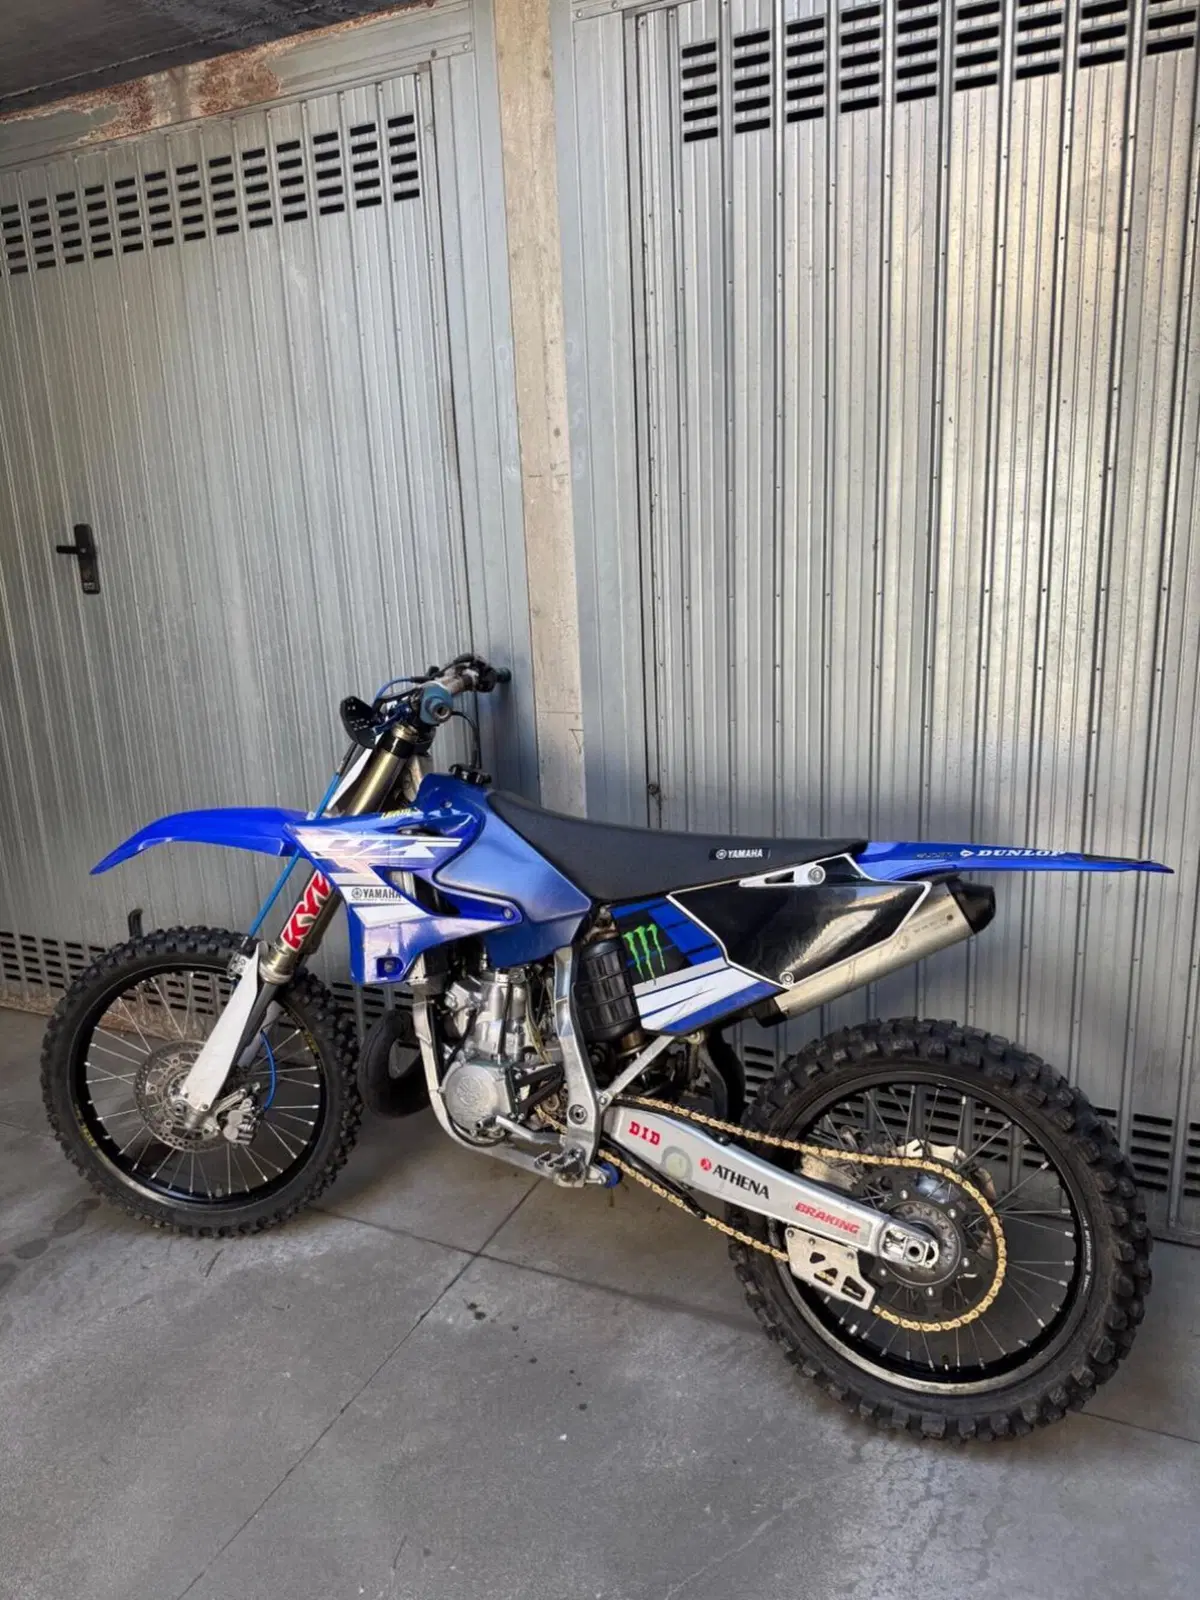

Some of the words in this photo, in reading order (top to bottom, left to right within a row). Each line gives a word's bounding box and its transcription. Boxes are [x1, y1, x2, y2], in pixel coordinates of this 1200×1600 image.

[728, 848, 763, 859] YAMAHA
[976, 849, 1066, 857] DUNLOP
[629, 1121, 660, 1146] DID
[712, 1165, 769, 1199] ATHENA
[795, 1202, 860, 1234] BRAKING
